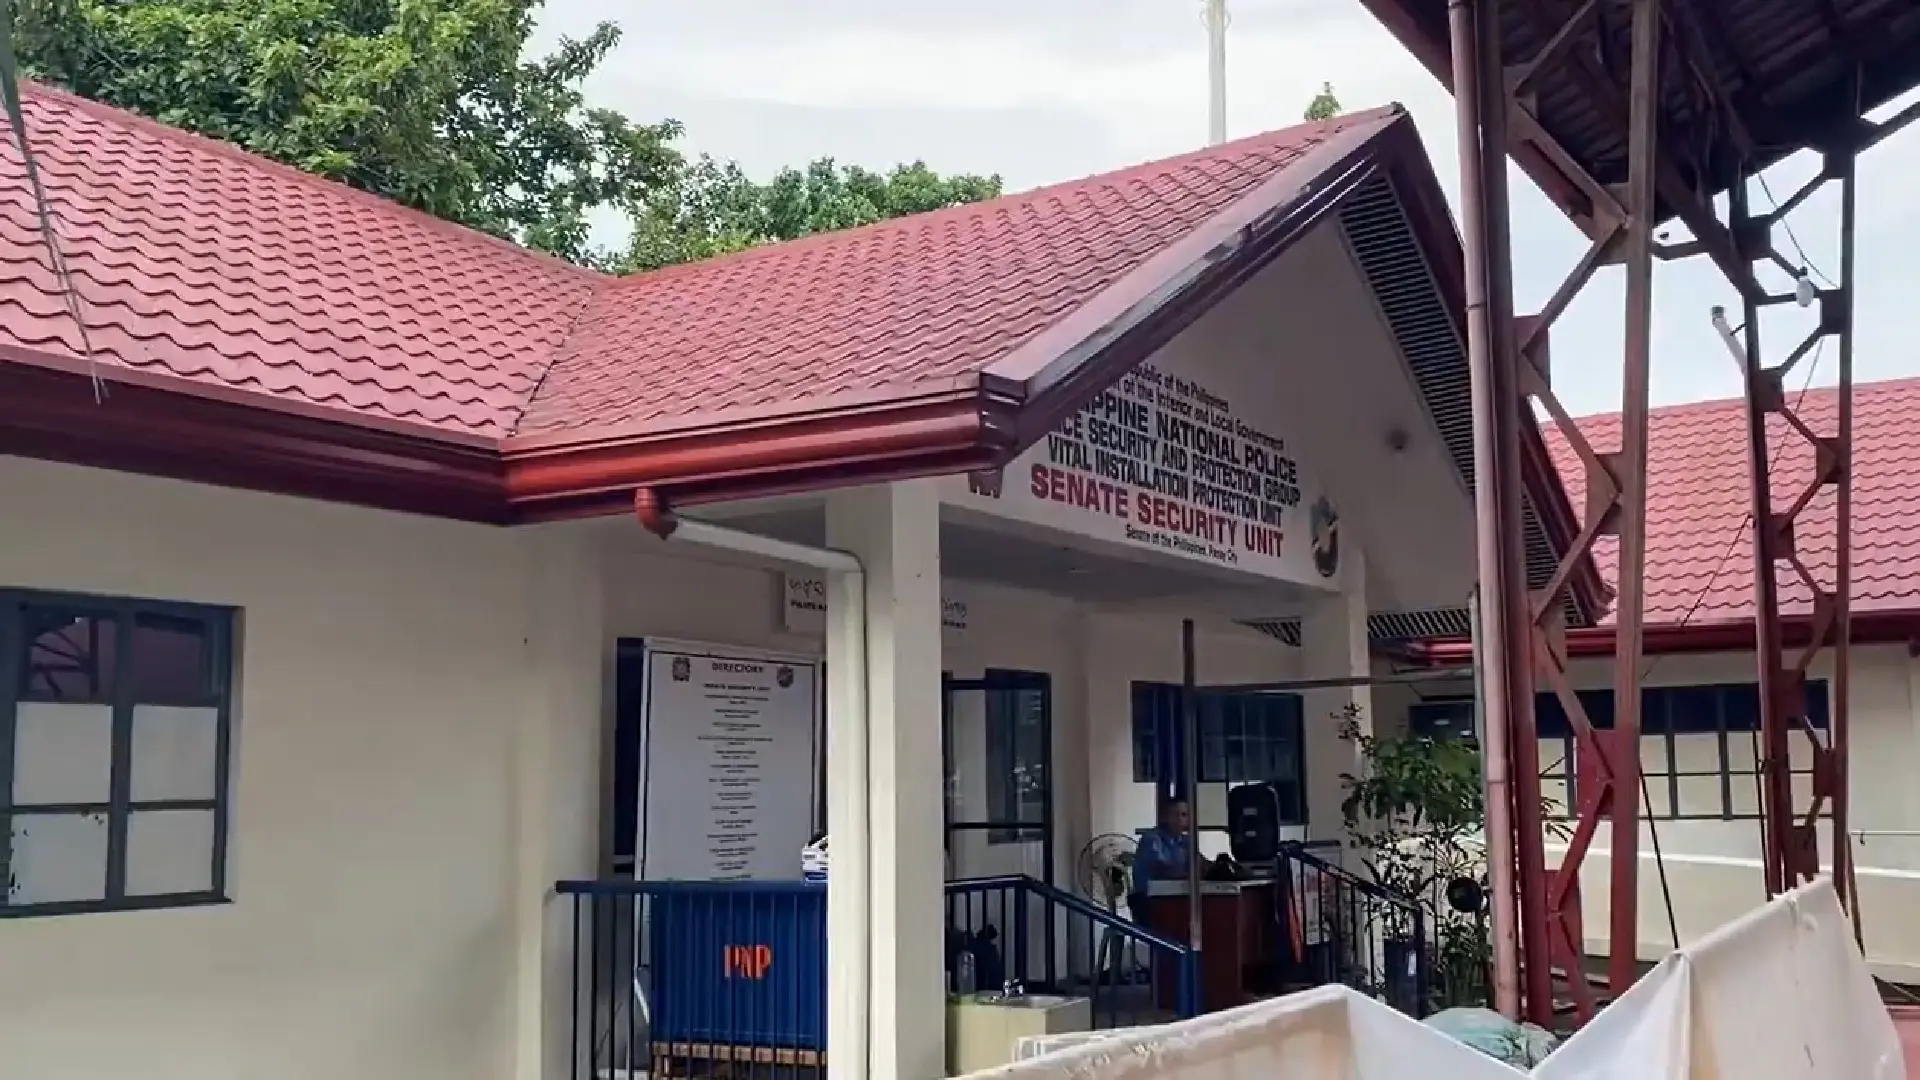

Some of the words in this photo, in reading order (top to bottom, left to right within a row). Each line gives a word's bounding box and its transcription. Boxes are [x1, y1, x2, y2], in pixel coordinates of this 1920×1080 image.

[1156, 411, 1240, 464] NATIONAL
[1244, 443, 1297, 484] POLICE
[1210, 407, 1233, 433] Local
[1048, 434, 1092, 472] VITAL
[1095, 448, 1188, 501] INSTALLATION
[1192, 478, 1258, 521] PROTECTION
[1260, 500, 1283, 529] UNIT
[1089, 417, 1157, 462] SECURITY
[1161, 442, 1188, 472] AND
[1192, 453, 1261, 497] PROTECTION
[1264, 477, 1301, 507] GROUP
[1031, 462, 1128, 518] SENATE
[1137, 492, 1237, 547] SECURITY
[1244, 522, 1284, 558] UNIT
[711, 662, 764, 673] DIRECTORY
[724, 944, 771, 979] PNP
